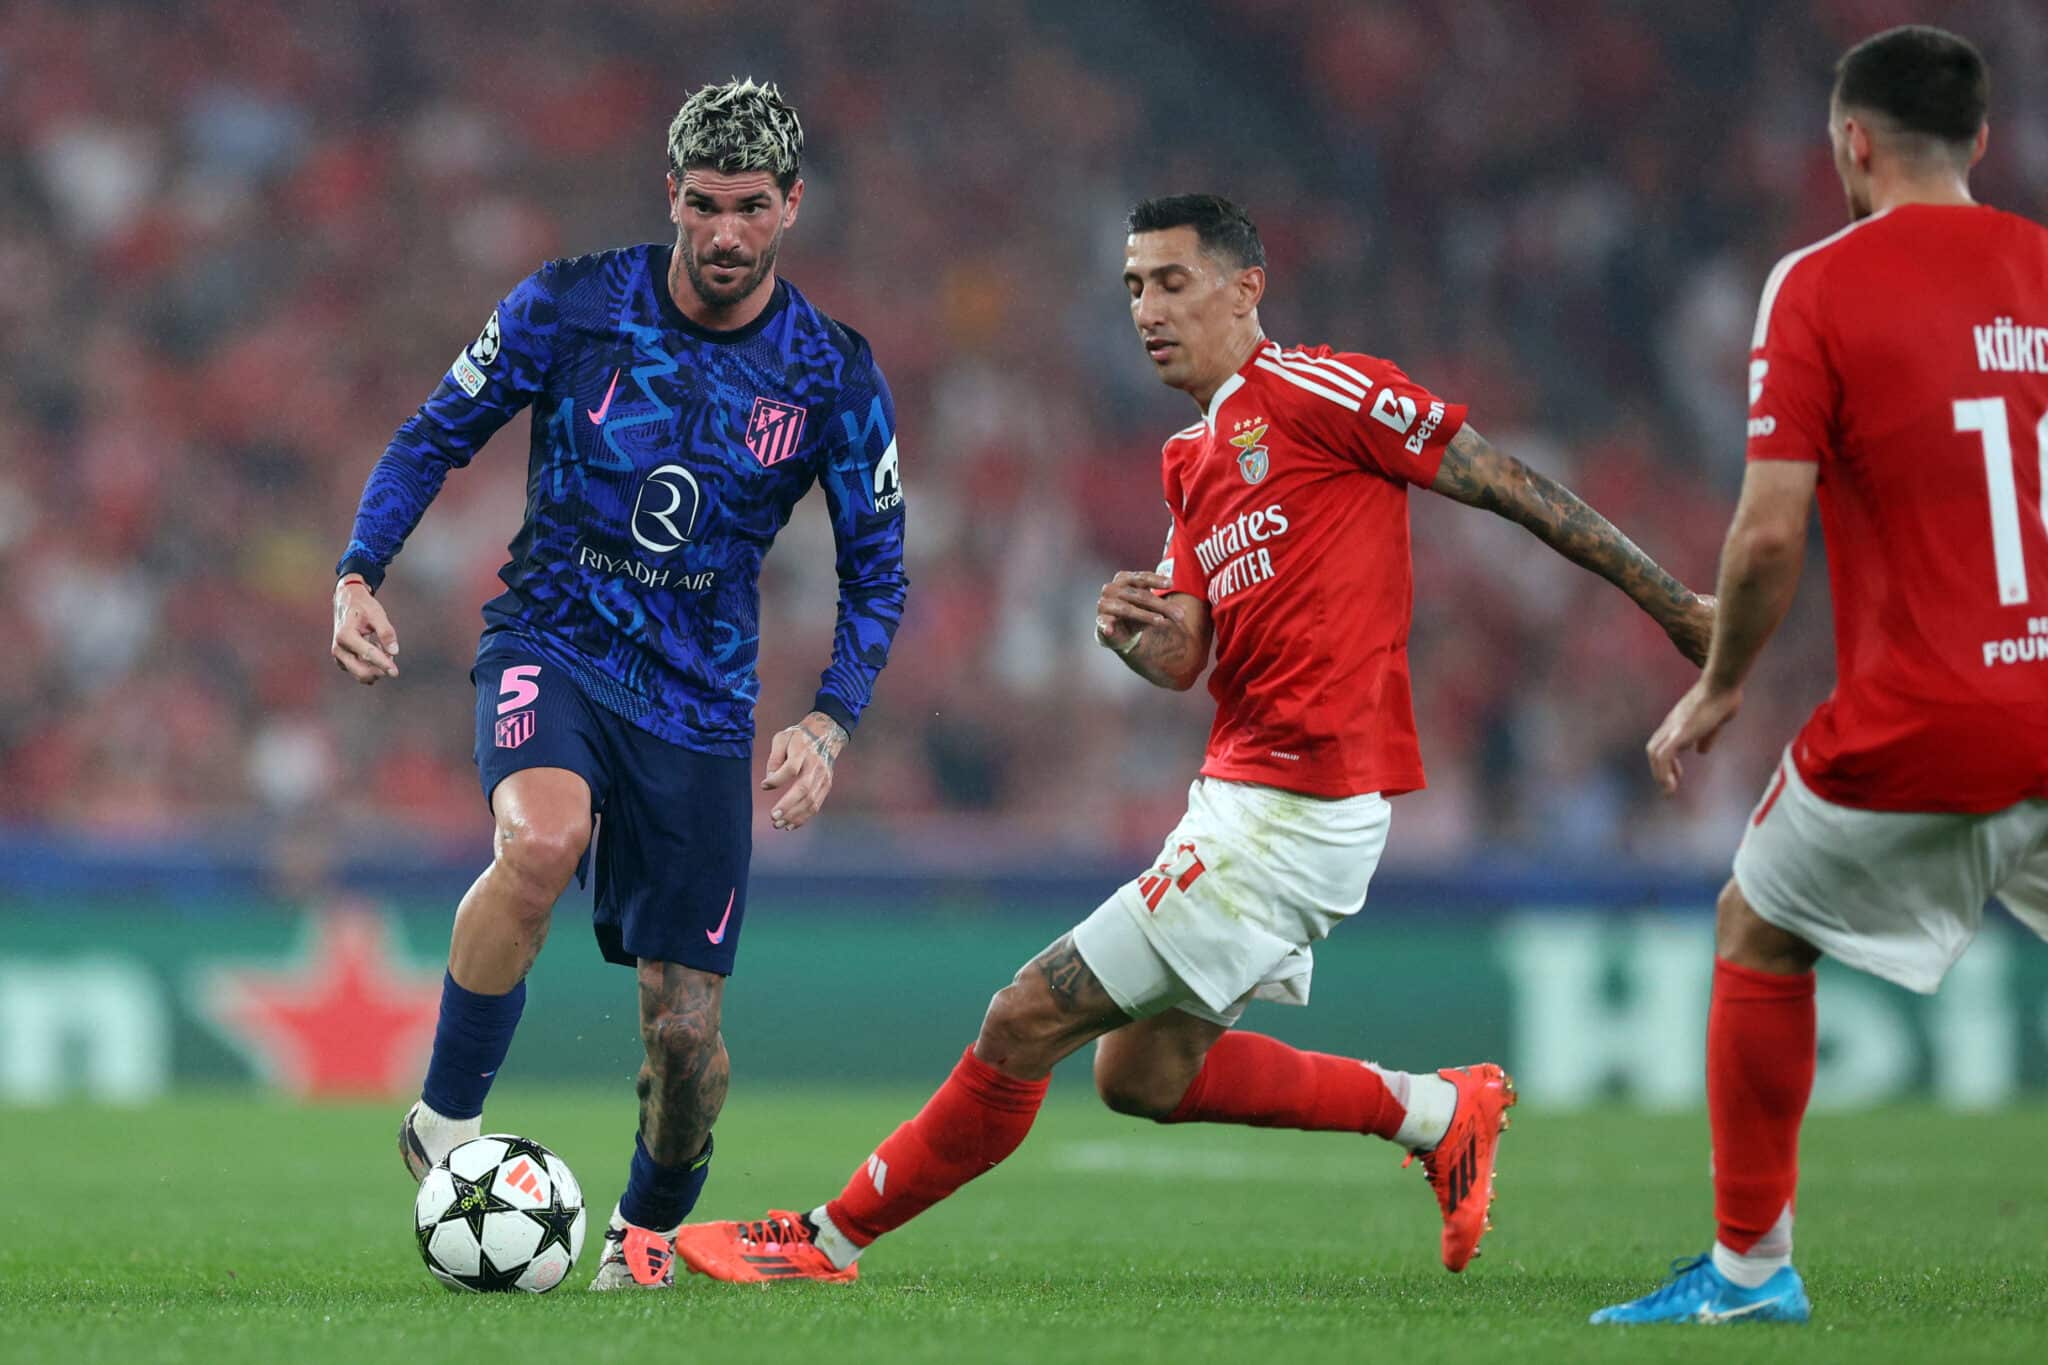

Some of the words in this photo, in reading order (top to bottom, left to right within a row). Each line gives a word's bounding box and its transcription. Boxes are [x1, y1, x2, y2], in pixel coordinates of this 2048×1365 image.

[1404, 401, 1445, 455] Betan
[1194, 504, 1289, 575] mirates
[579, 546, 670, 588] RIYADH
[673, 571, 715, 591] AIR
[497, 665, 542, 715] 5
